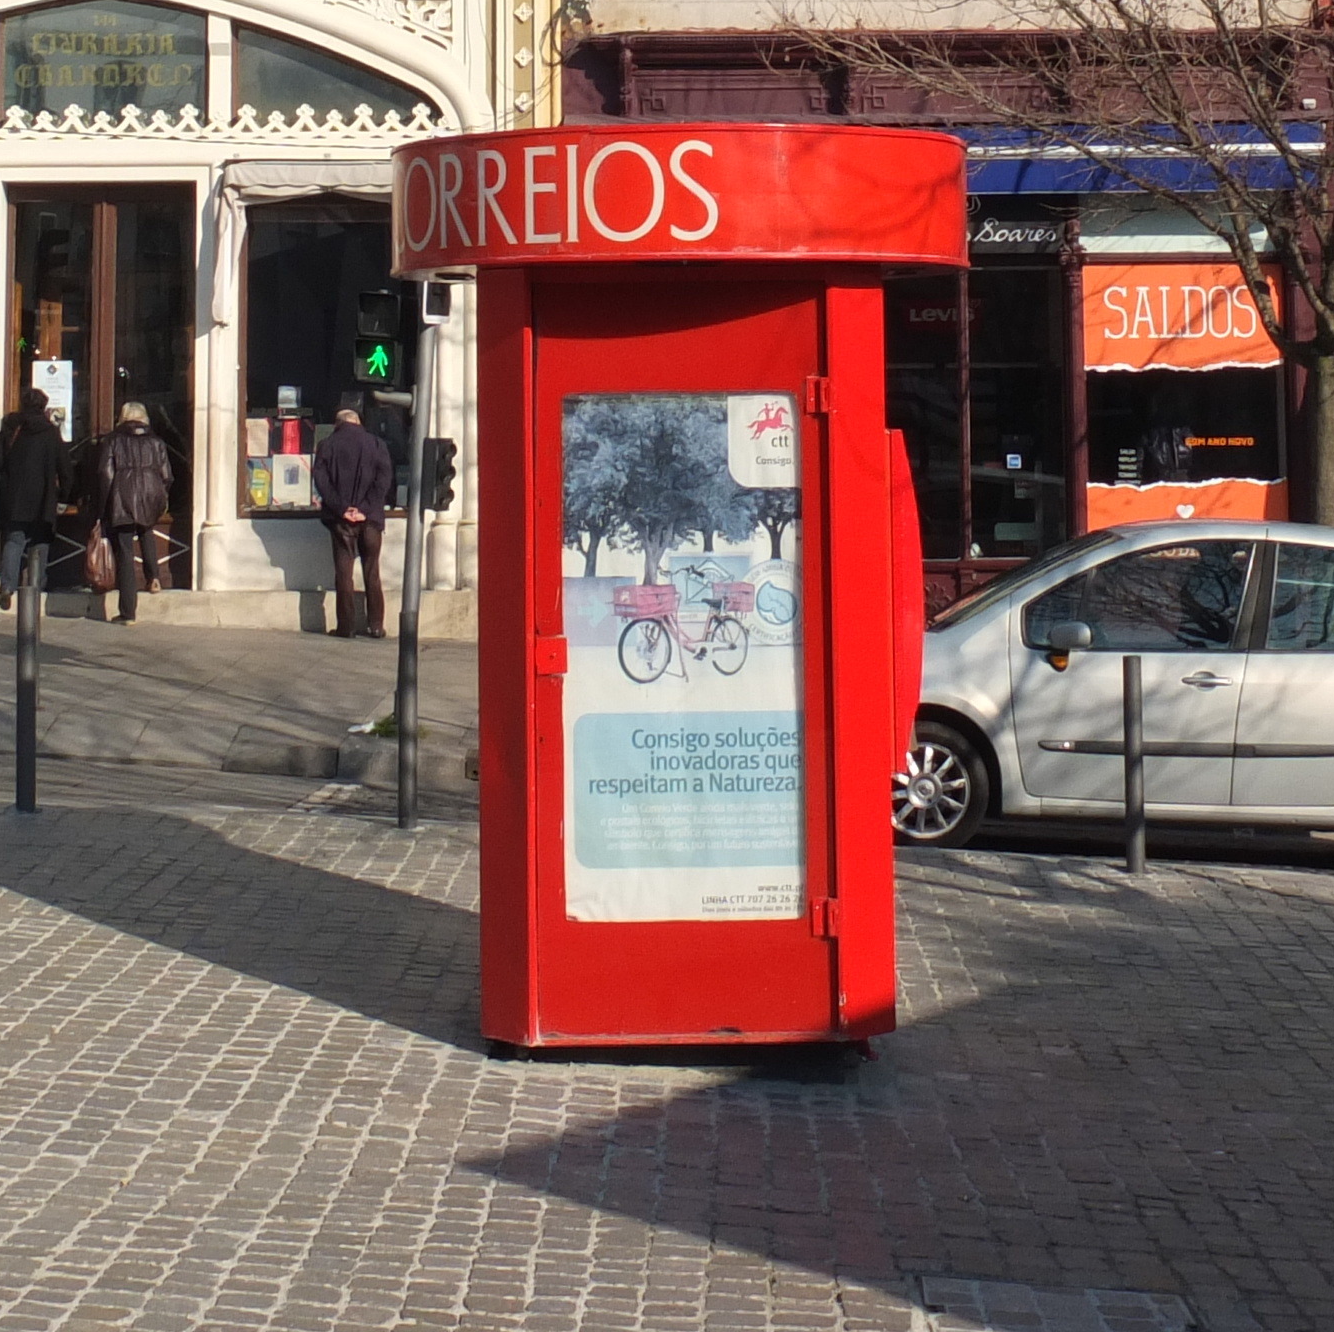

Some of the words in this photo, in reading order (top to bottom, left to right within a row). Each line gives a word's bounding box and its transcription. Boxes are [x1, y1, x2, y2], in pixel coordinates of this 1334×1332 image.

[400, 140, 719, 252] ORREIOS
[974, 217, 1058, 243] Soares
[1103, 285, 1257, 339] SALDOS
[771, 435, 789, 448] ctt
[631, 728, 710, 753] Consigo
[715, 726, 801, 751] soluções
[650, 751, 760, 771] inovadoras
[764, 753, 802, 775] que
[588, 773, 687, 799] respeitam
[693, 777, 704, 793] a
[709, 772, 803, 794] Natureza.
[701, 895, 728, 905] LINHA
[730, 895, 745, 904] CTT
[747, 895, 763, 904] 707
